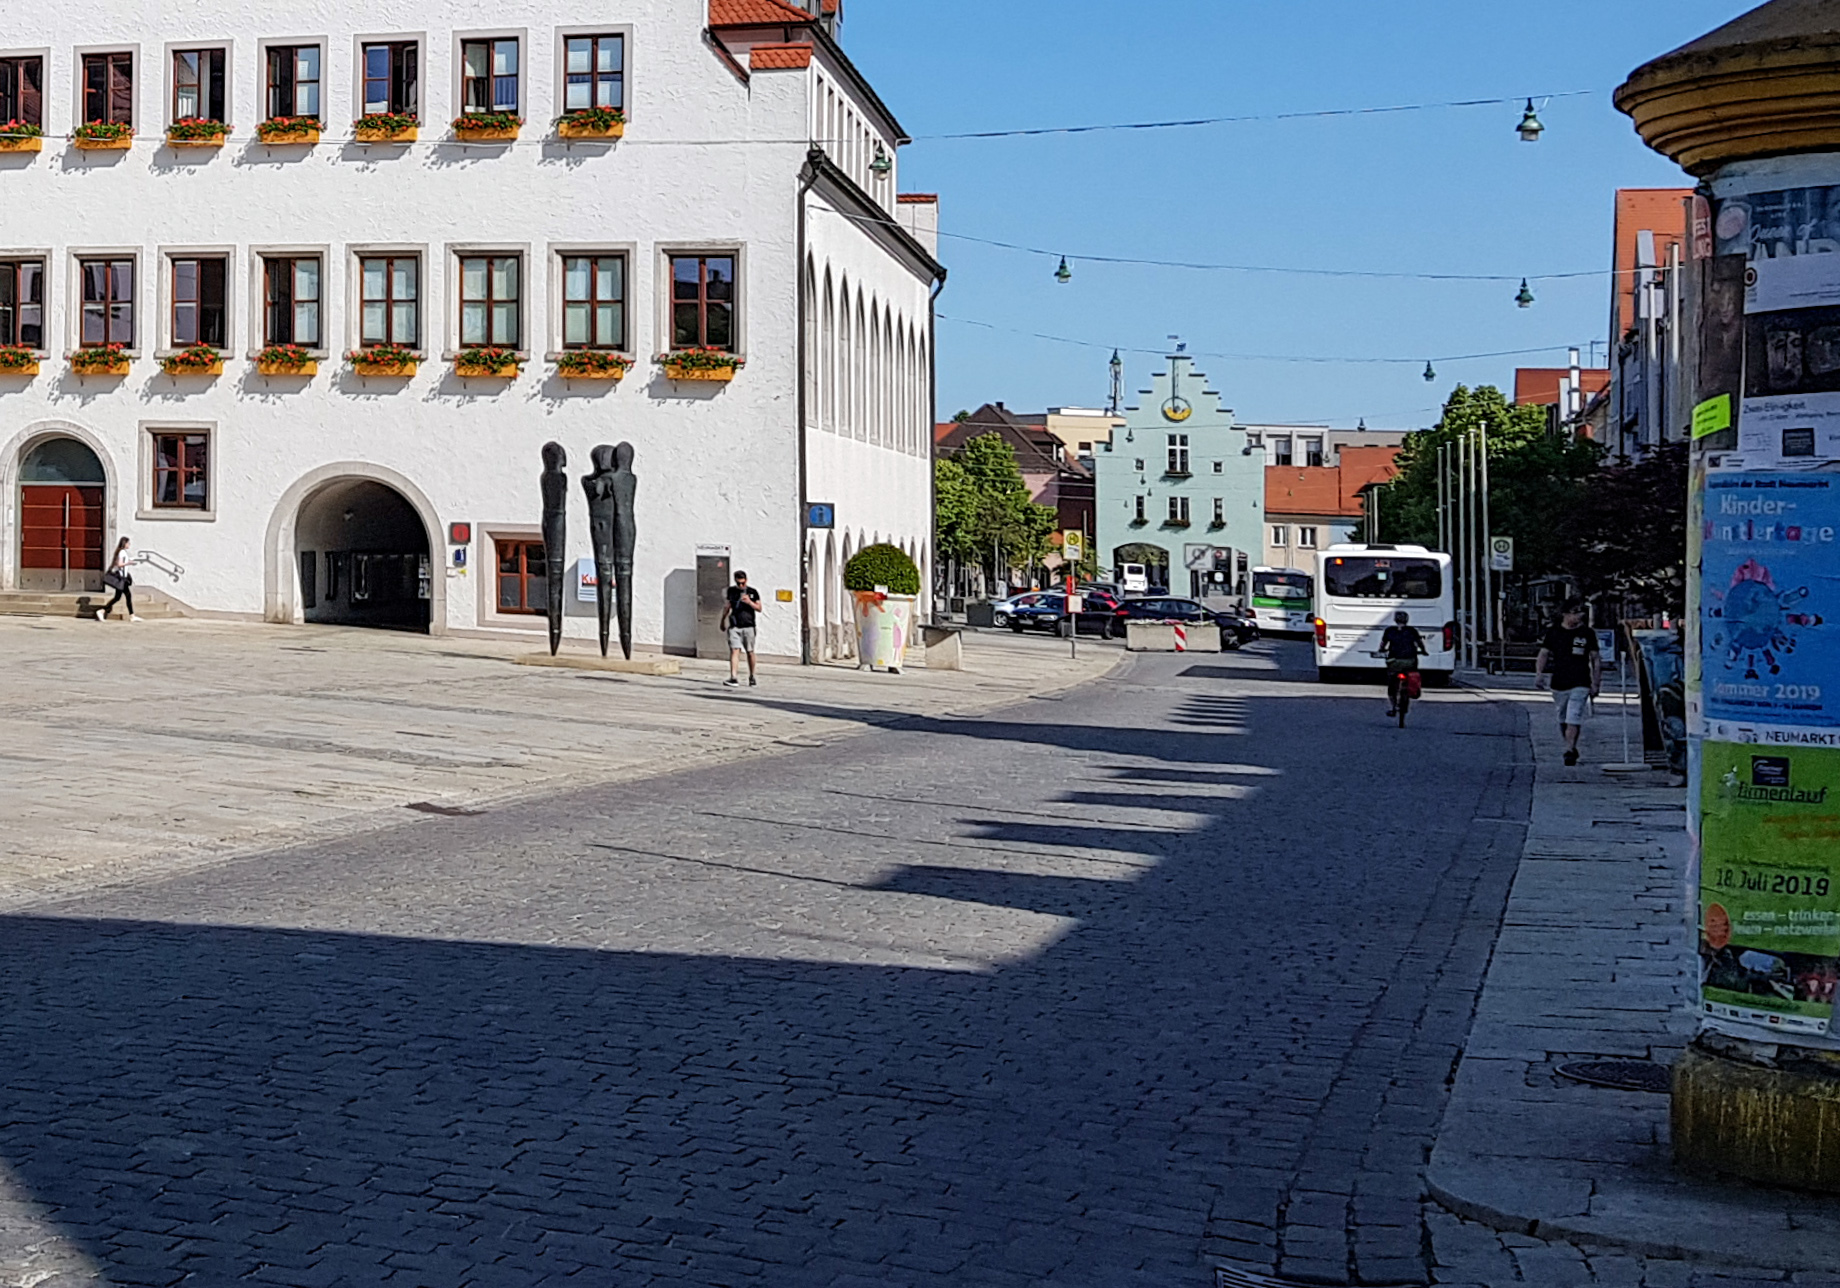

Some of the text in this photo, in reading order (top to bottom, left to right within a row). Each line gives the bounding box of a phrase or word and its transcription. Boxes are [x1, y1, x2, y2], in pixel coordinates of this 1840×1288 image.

[1720, 493, 1797, 515] Kinder-
[1774, 683, 1821, 700] 2019
[1765, 730, 1836, 746] NEUMARKT
[1715, 867, 1830, 897] 18. Juli 2019
